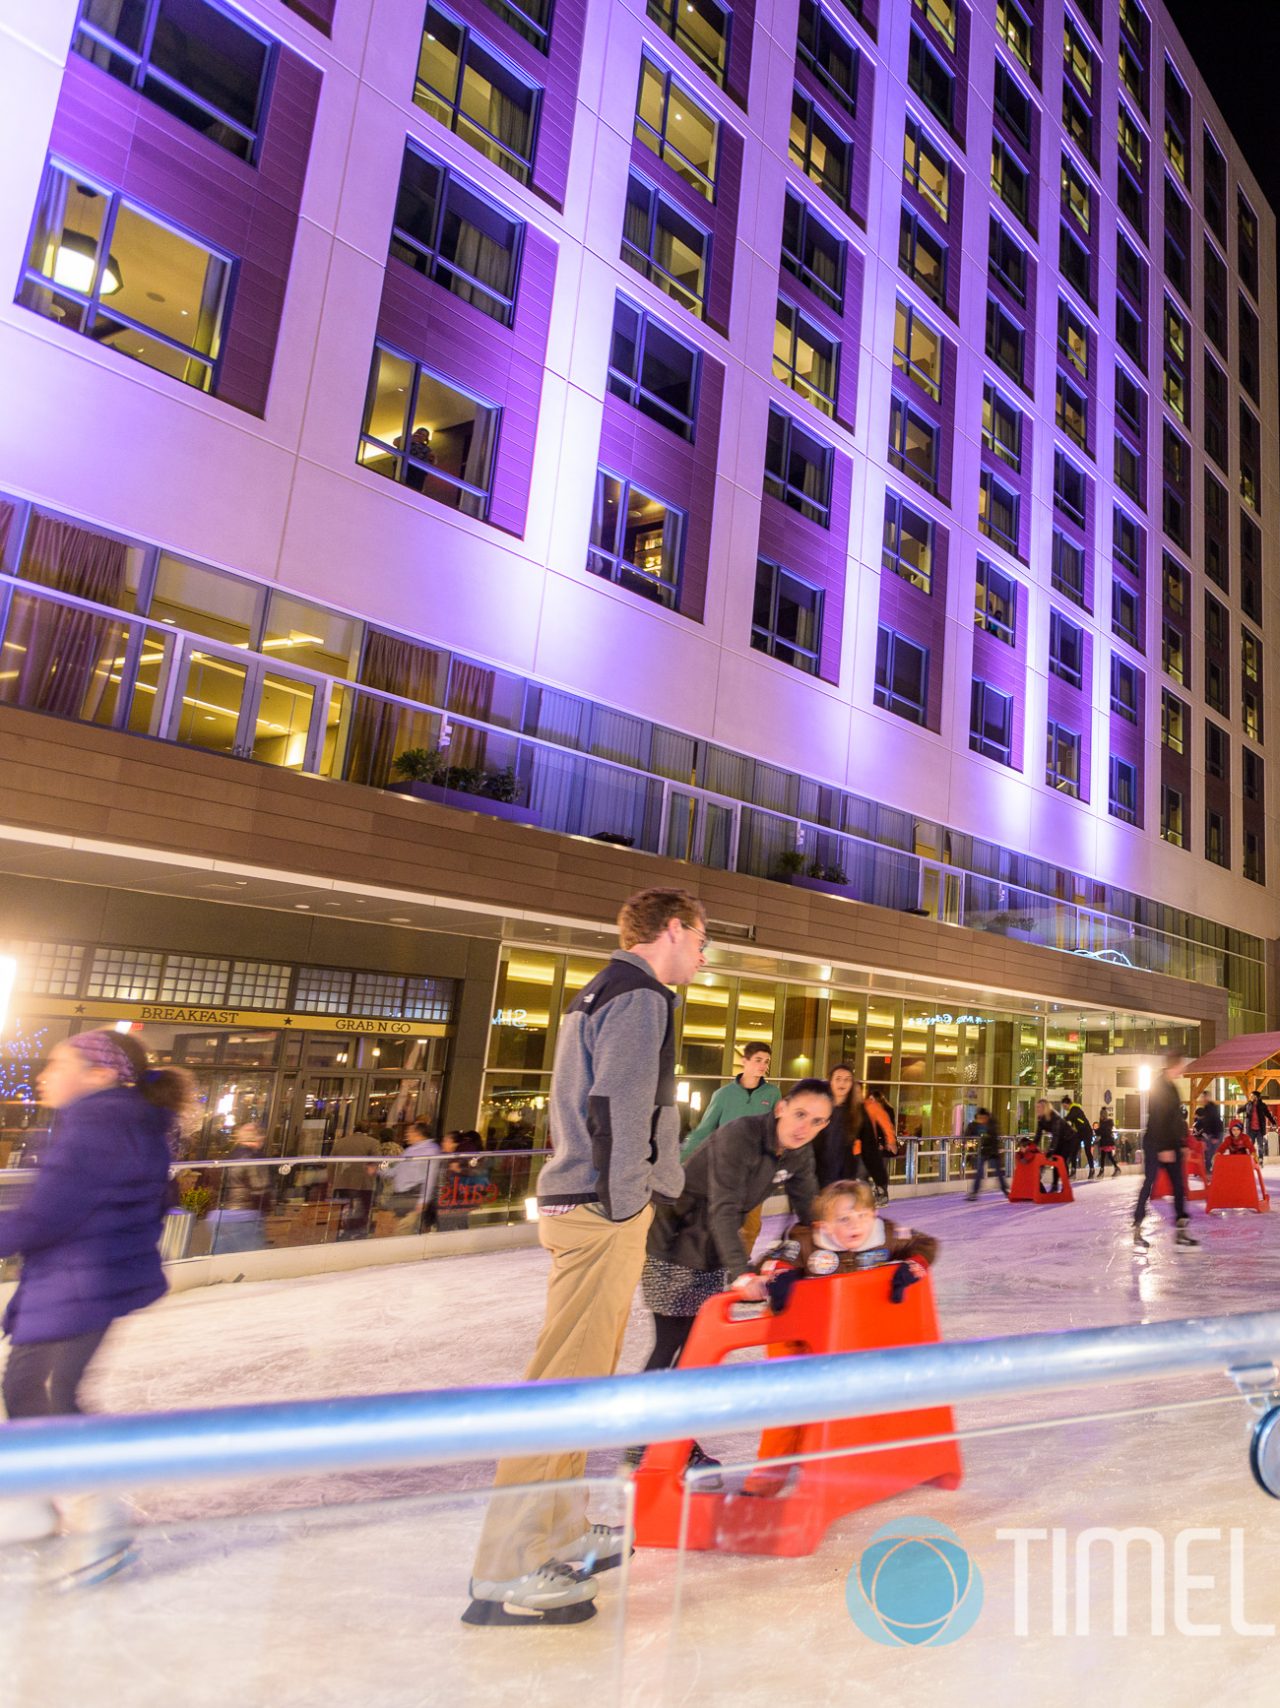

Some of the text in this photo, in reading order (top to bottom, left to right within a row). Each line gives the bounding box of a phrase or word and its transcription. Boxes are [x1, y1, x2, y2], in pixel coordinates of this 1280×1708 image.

[140, 1007, 239, 1024] BREAKFAST
[335, 1019, 411, 1033] GRAB N GO
